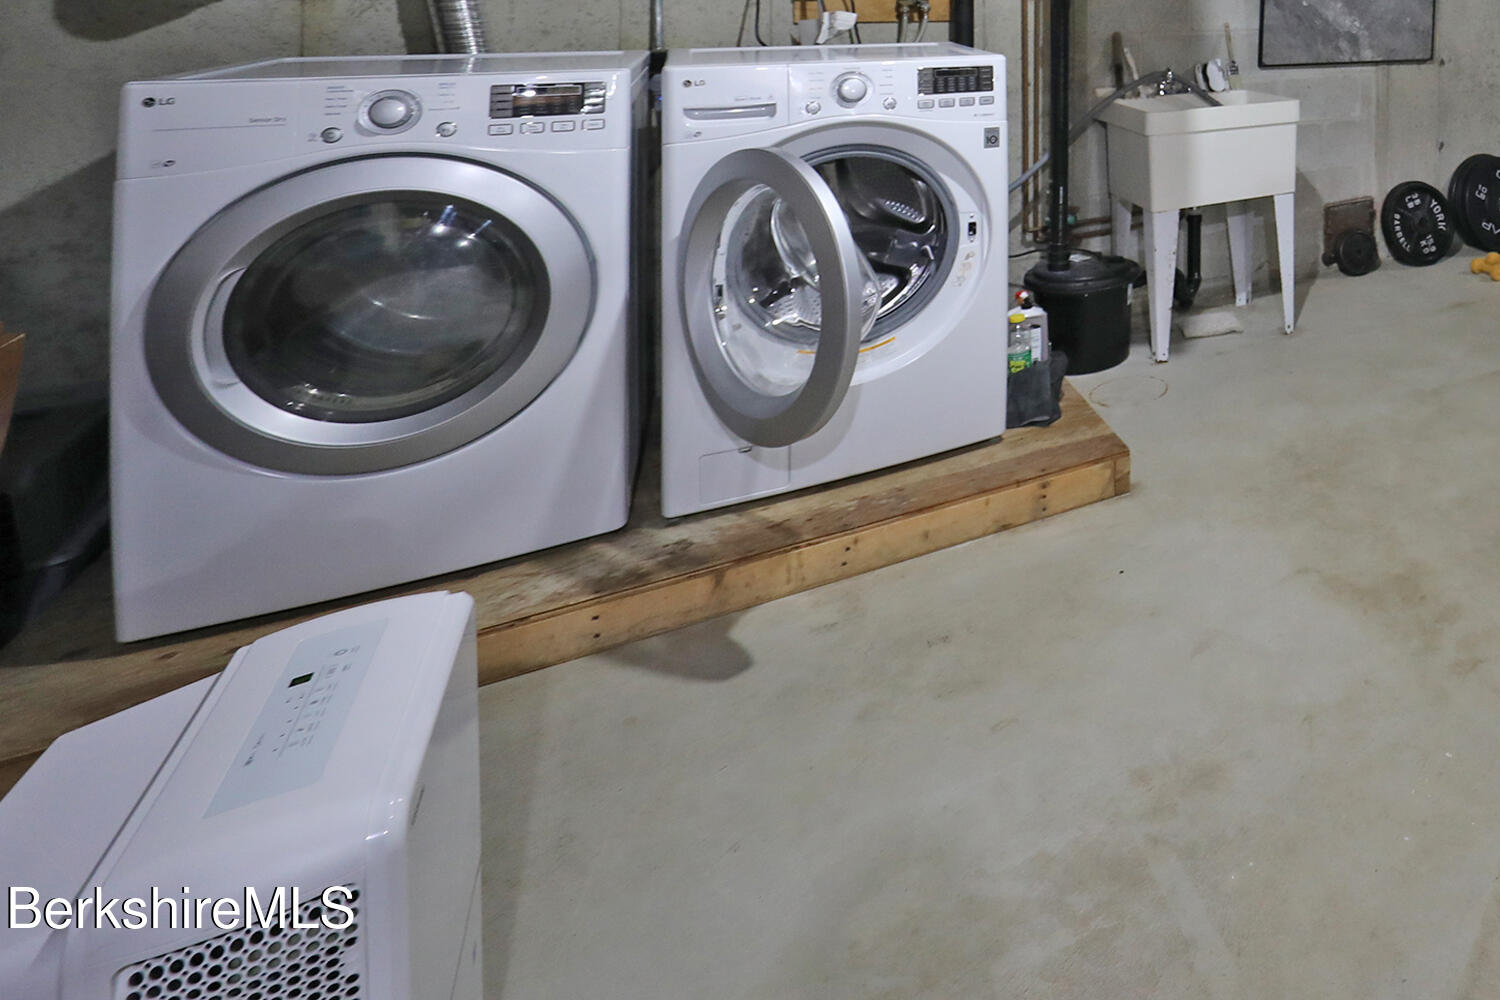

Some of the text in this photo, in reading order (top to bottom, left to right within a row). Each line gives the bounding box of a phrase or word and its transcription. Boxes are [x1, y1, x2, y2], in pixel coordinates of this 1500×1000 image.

[1478, 184, 1488, 194] 10
[1429, 198, 1448, 231] YORK
[1393, 213, 1411, 253] BARBELL
